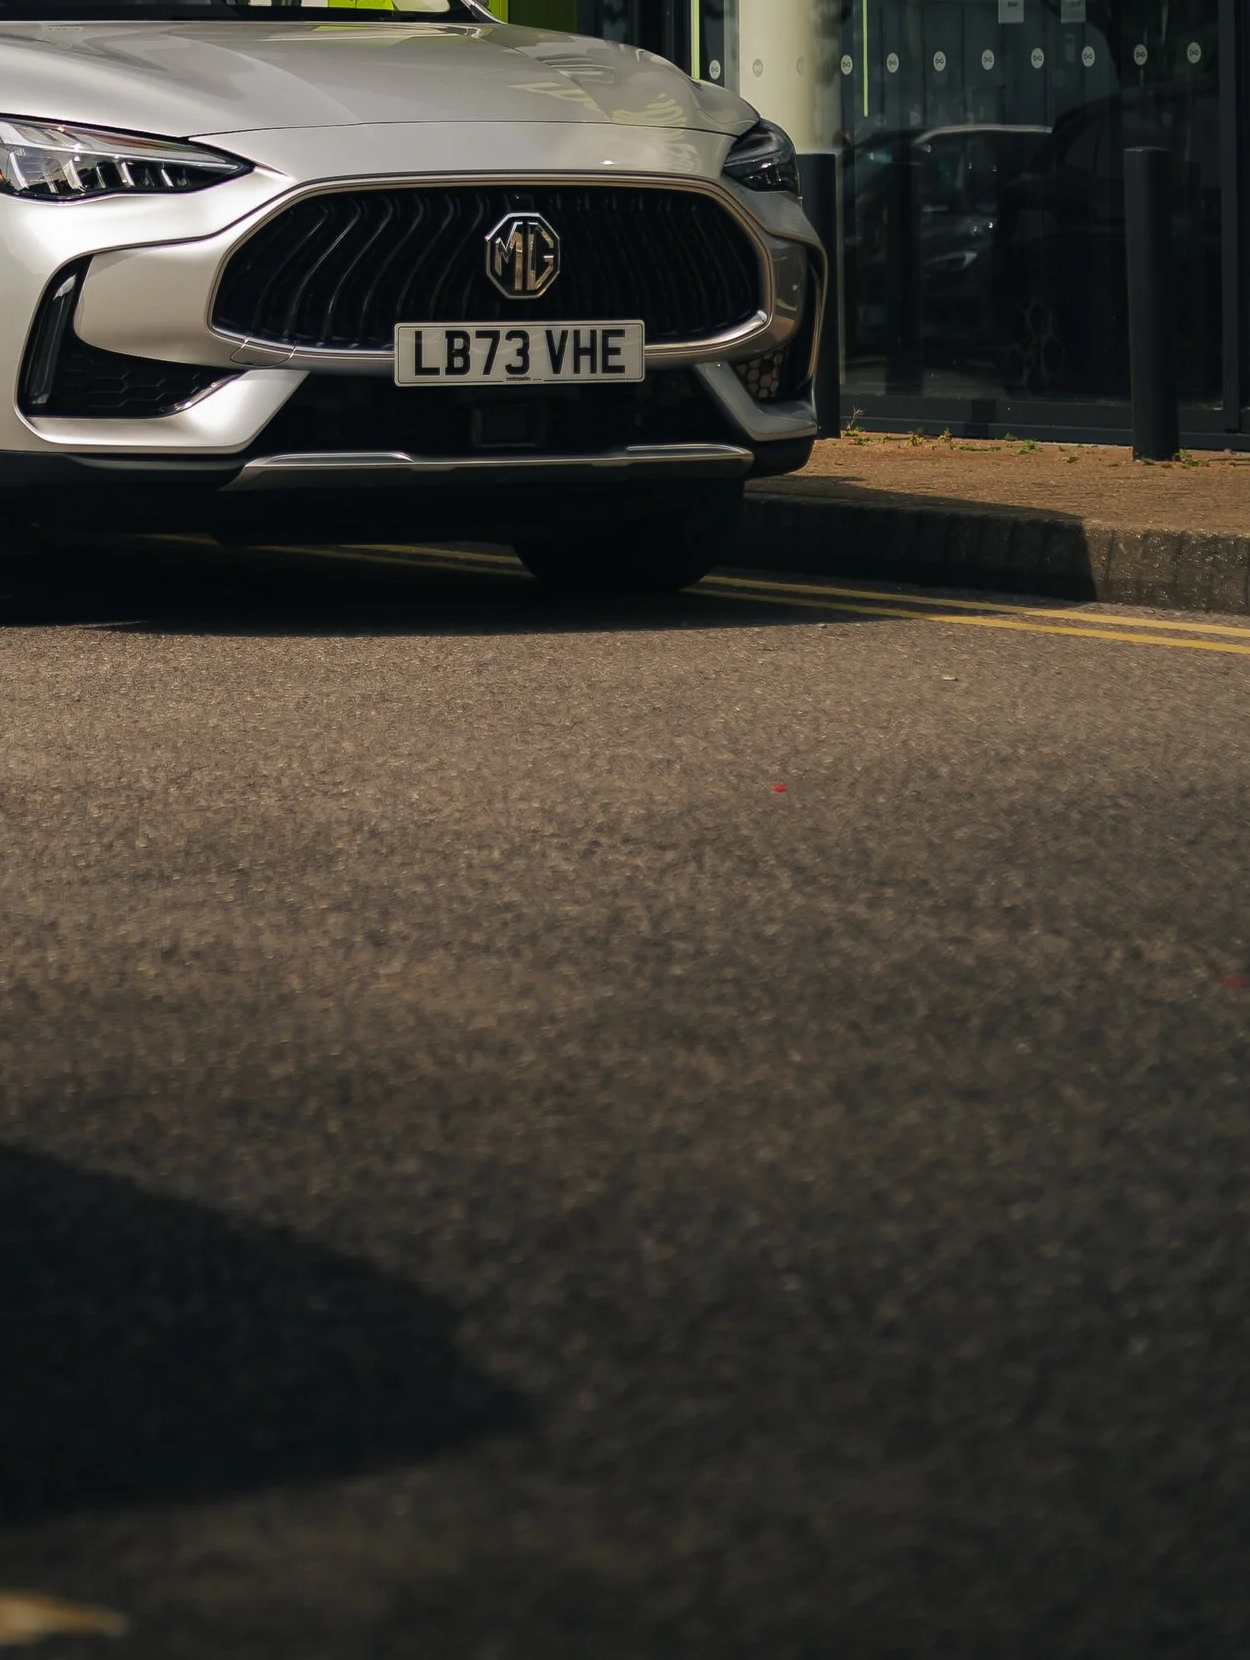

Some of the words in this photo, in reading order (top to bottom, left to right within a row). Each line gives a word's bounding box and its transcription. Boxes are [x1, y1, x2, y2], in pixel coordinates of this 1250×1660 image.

[494, 221, 556, 292] MG
[414, 329, 531, 377] LB73
[545, 328, 627, 376] VHE
